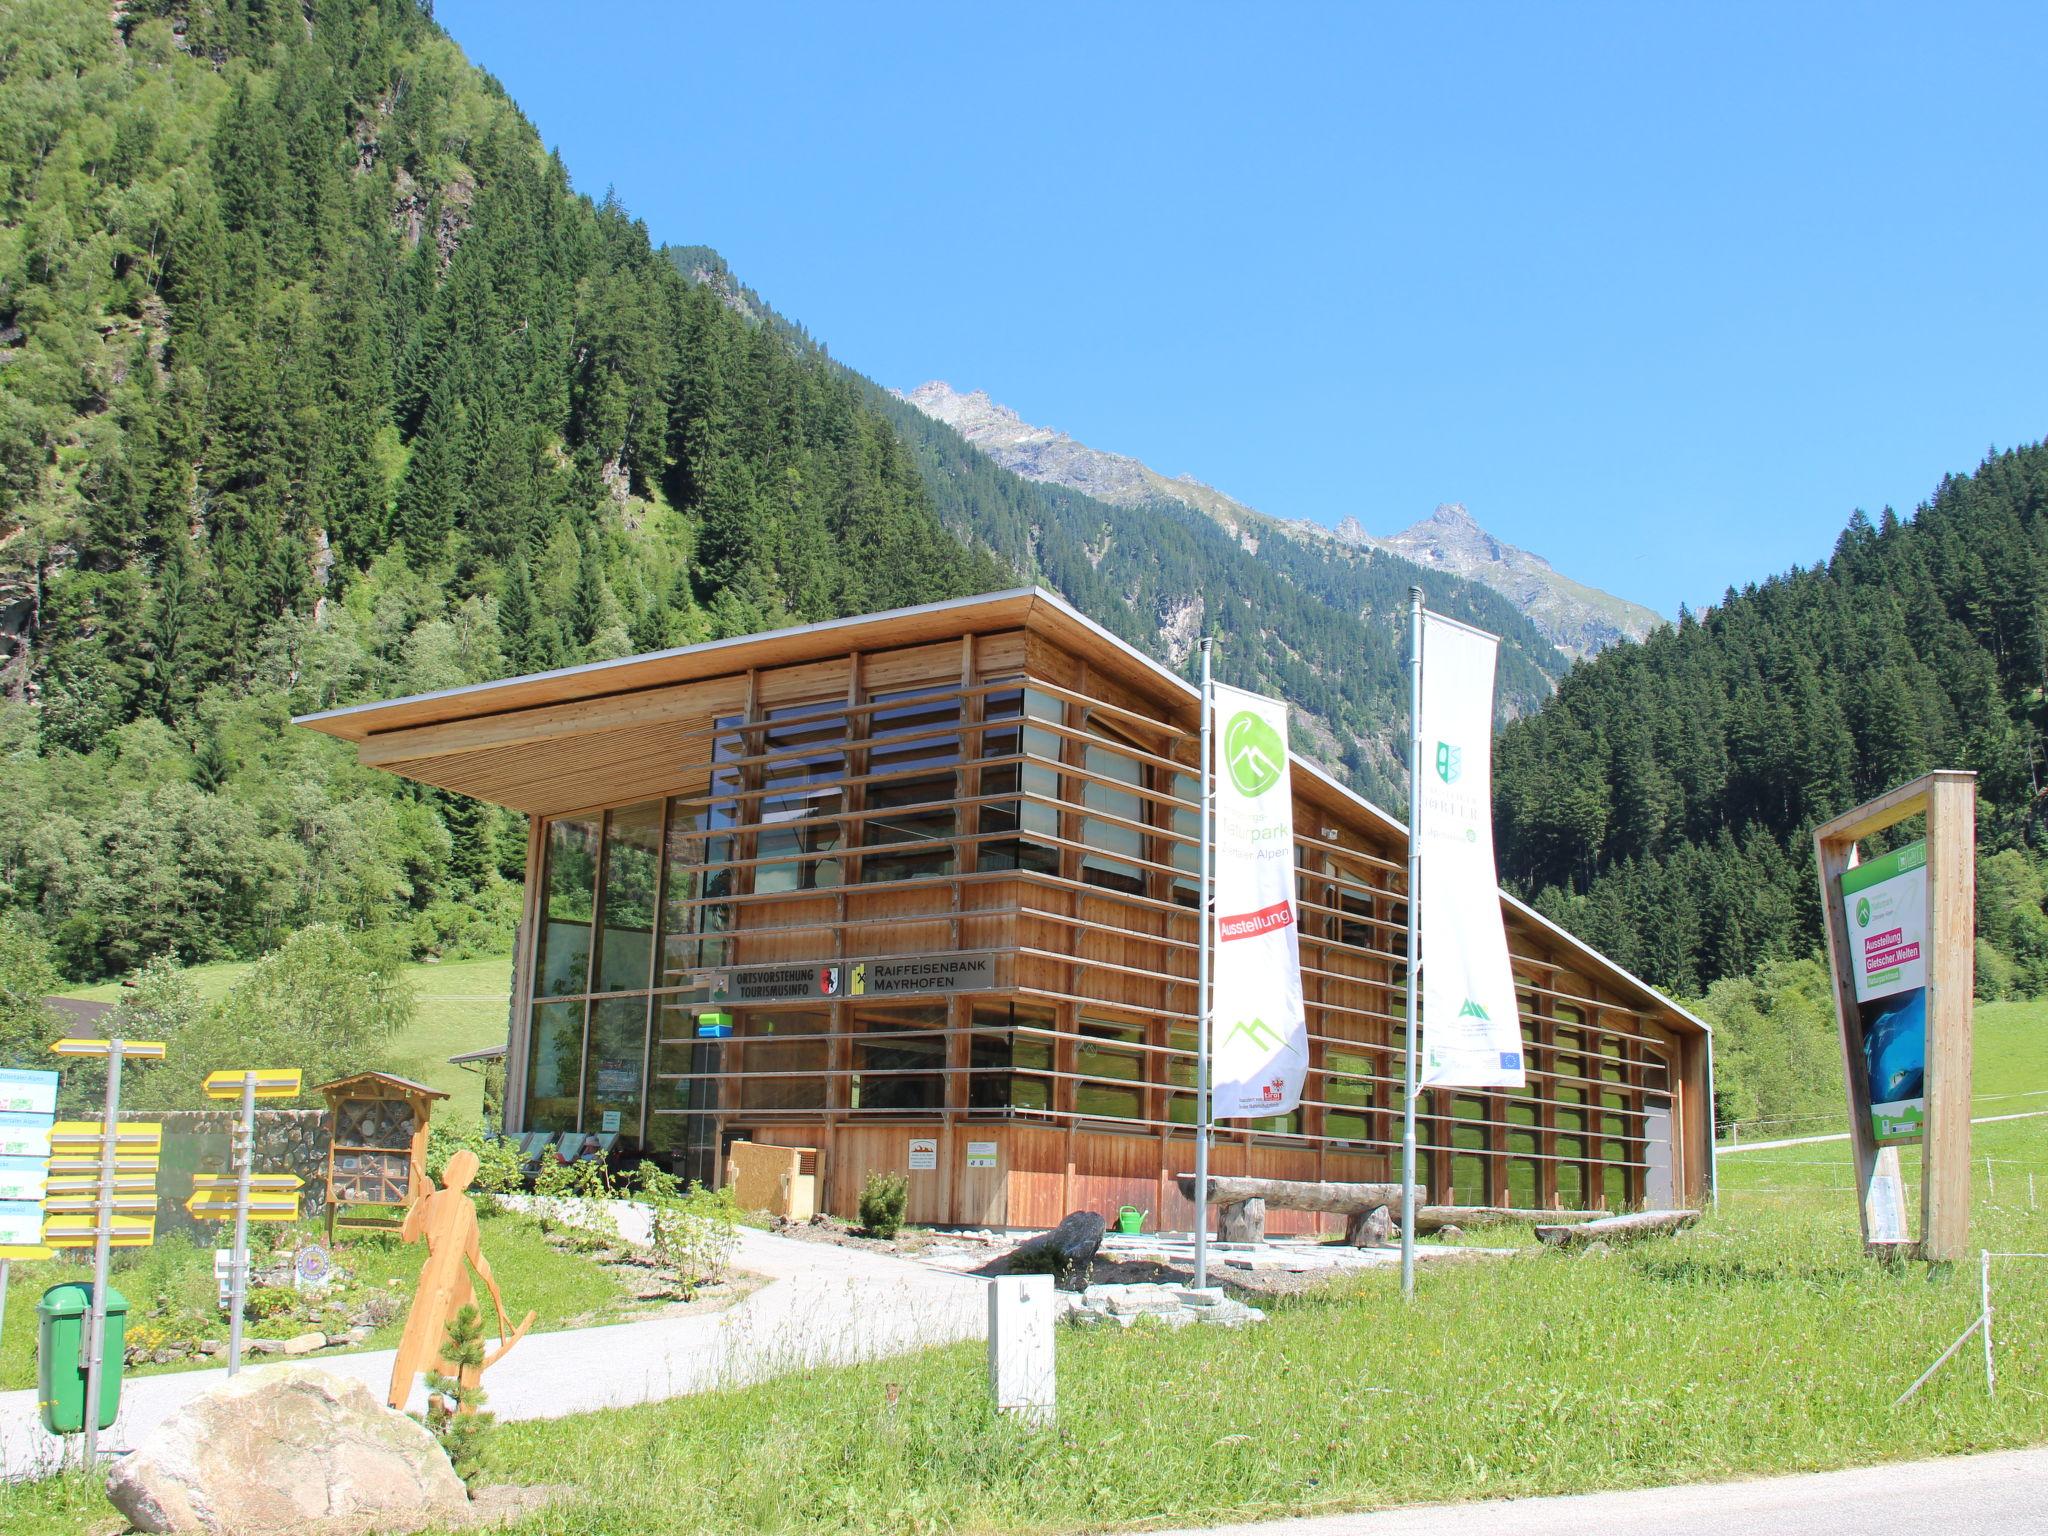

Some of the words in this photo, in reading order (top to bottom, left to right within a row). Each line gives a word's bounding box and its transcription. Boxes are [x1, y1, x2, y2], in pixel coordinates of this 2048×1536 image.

[1257, 847, 1289, 862] Alpen
[1221, 908, 1290, 936] Ausstellung
[1866, 932, 1901, 950] Ausstellung
[1867, 947, 1918, 970] Gletscher.Welten
[736, 969, 814, 984] ORTSVORSTEHUNG
[874, 960, 986, 977] RAIFFEISENBANK
[741, 983, 809, 998] TOURISMUSINFO
[874, 977, 955, 991] MAYRHOFEN
